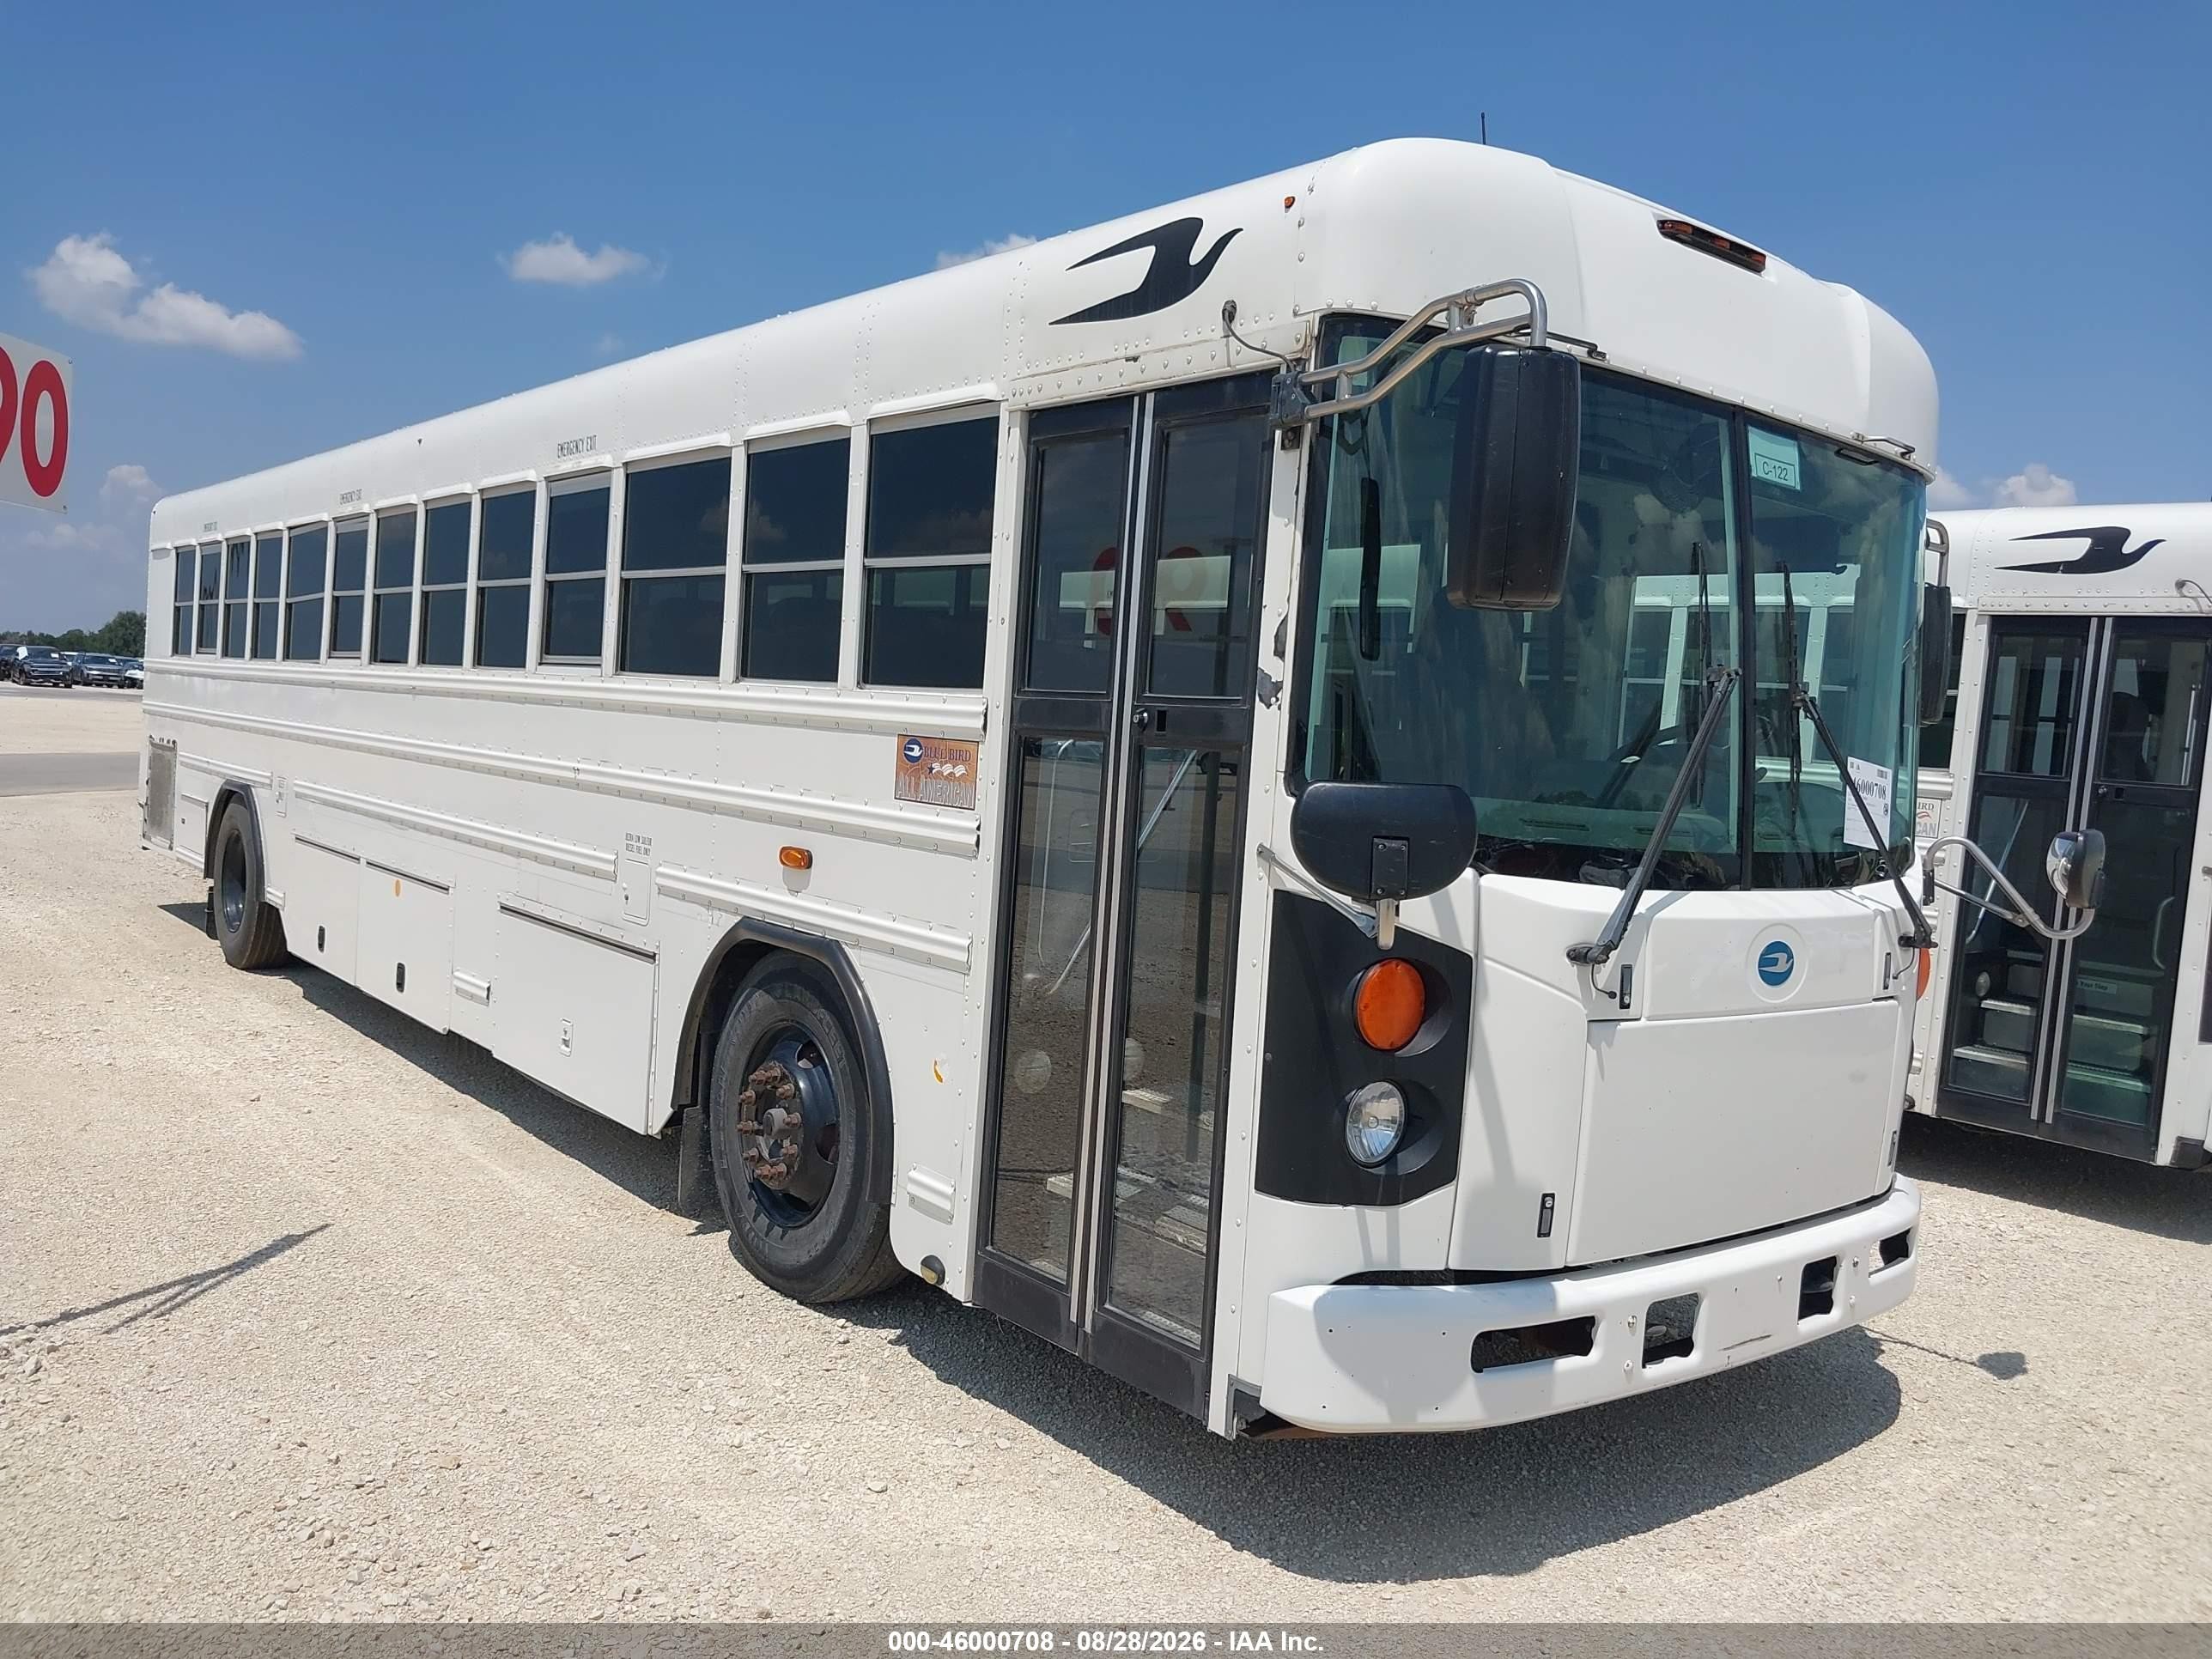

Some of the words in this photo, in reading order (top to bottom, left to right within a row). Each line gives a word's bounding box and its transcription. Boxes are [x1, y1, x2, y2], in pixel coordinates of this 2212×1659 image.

[557, 438, 584, 459] EMERGENCY
[586, 434, 597, 452] EXIT
[1762, 461, 1789, 482] C-122
[923, 745, 947, 759] BLUE
[949, 748, 971, 763] BIRD
[896, 772, 919, 799] ALL
[920, 775, 975, 808] AMERICAN
